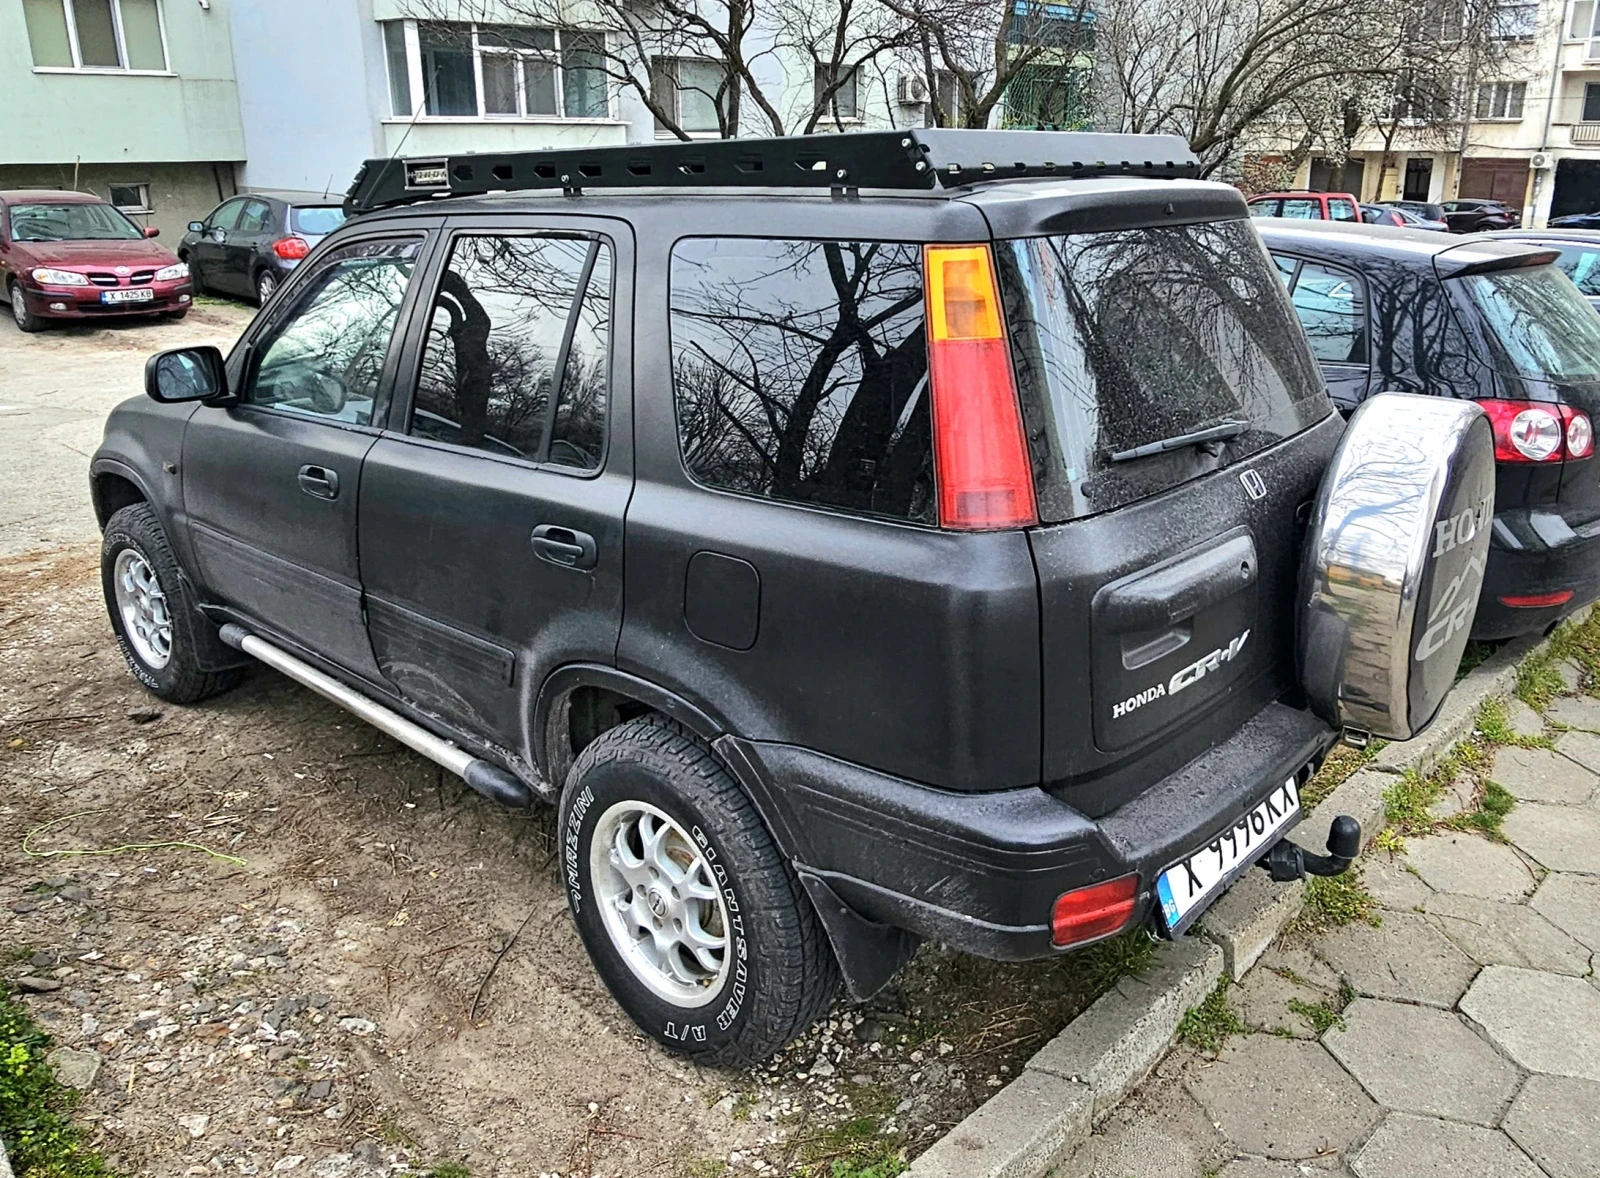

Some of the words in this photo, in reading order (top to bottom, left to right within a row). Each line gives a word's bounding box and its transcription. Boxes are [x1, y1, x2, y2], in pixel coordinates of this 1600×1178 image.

[1112, 683, 1166, 719] HONDA
[1168, 629, 1250, 695] CR-V
[566, 785, 595, 890] MAZZINI
[664, 1021, 707, 1042] A/T
